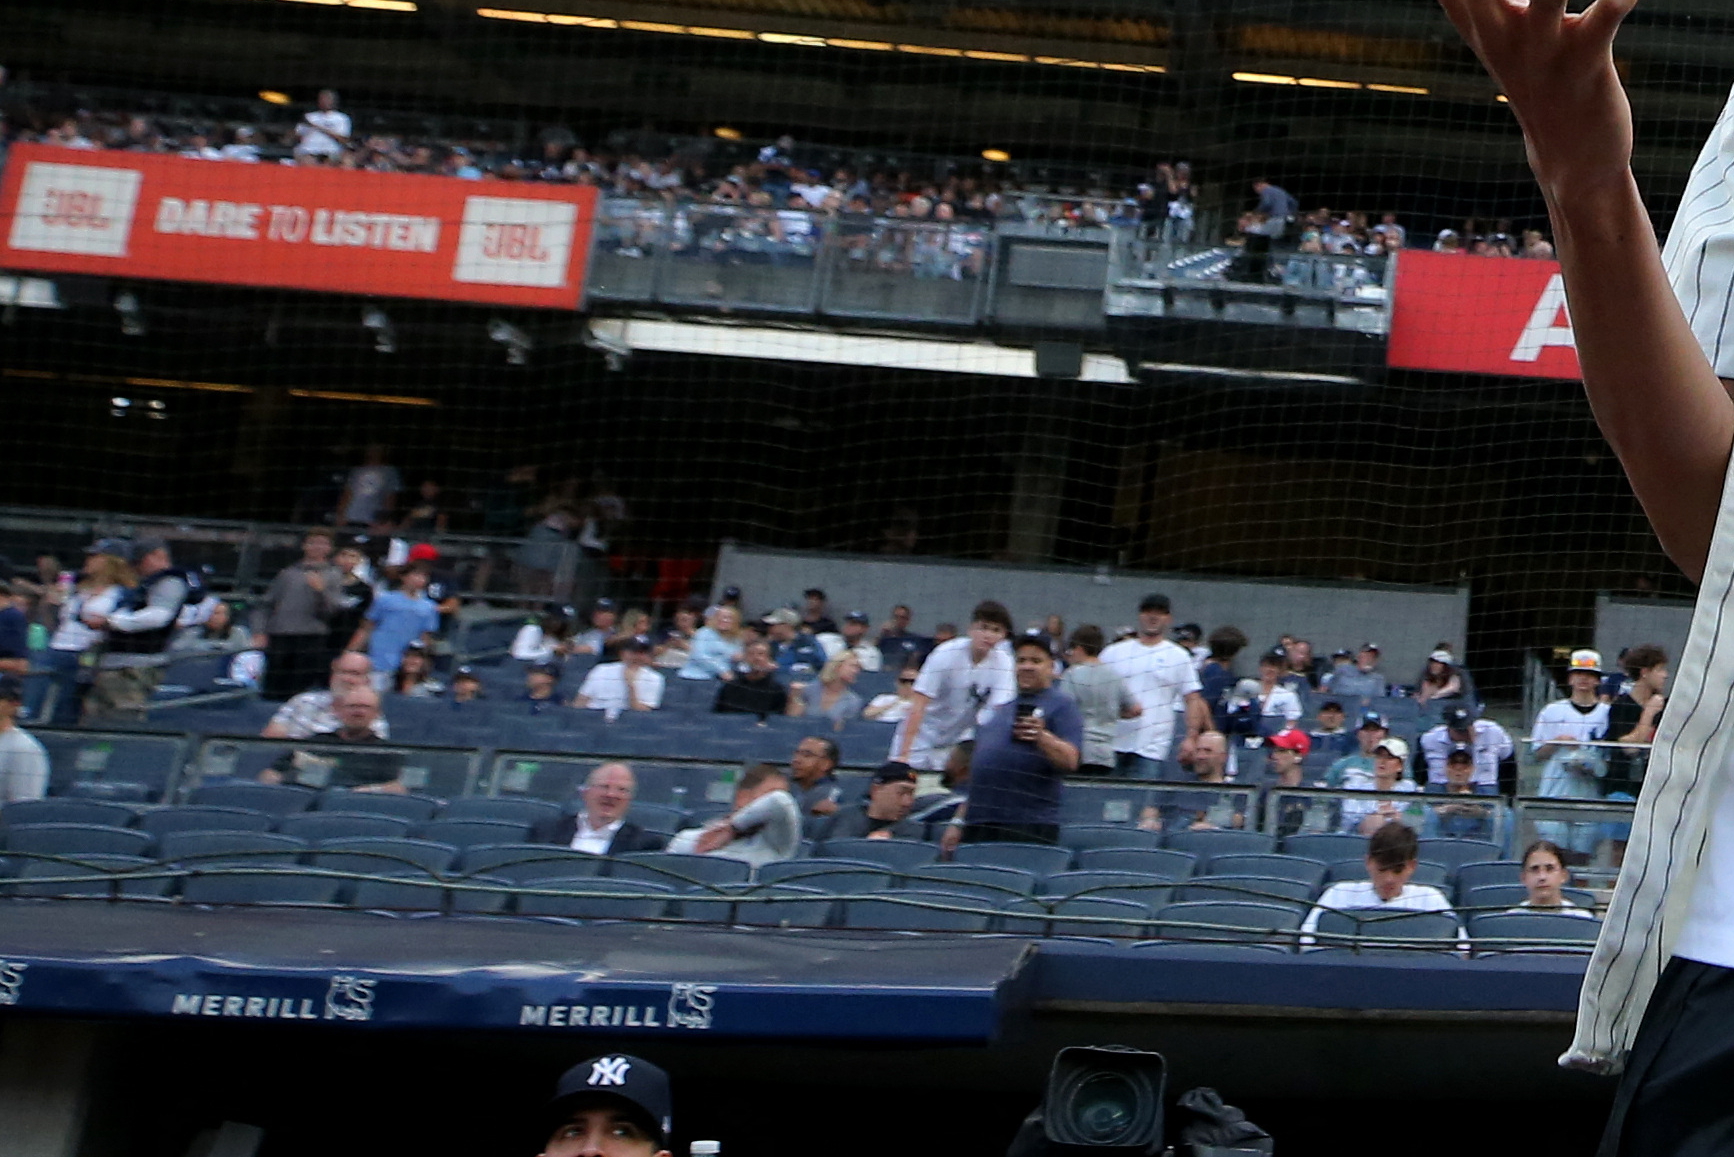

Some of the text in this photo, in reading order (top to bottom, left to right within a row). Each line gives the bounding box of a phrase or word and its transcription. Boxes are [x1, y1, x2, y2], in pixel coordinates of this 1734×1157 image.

[155, 197, 440, 253] DARE TO LISTEN
[171, 994, 318, 1020] MERRILL
[519, 1005, 660, 1028] MERRILL
[586, 1057, 631, 1086] NY
